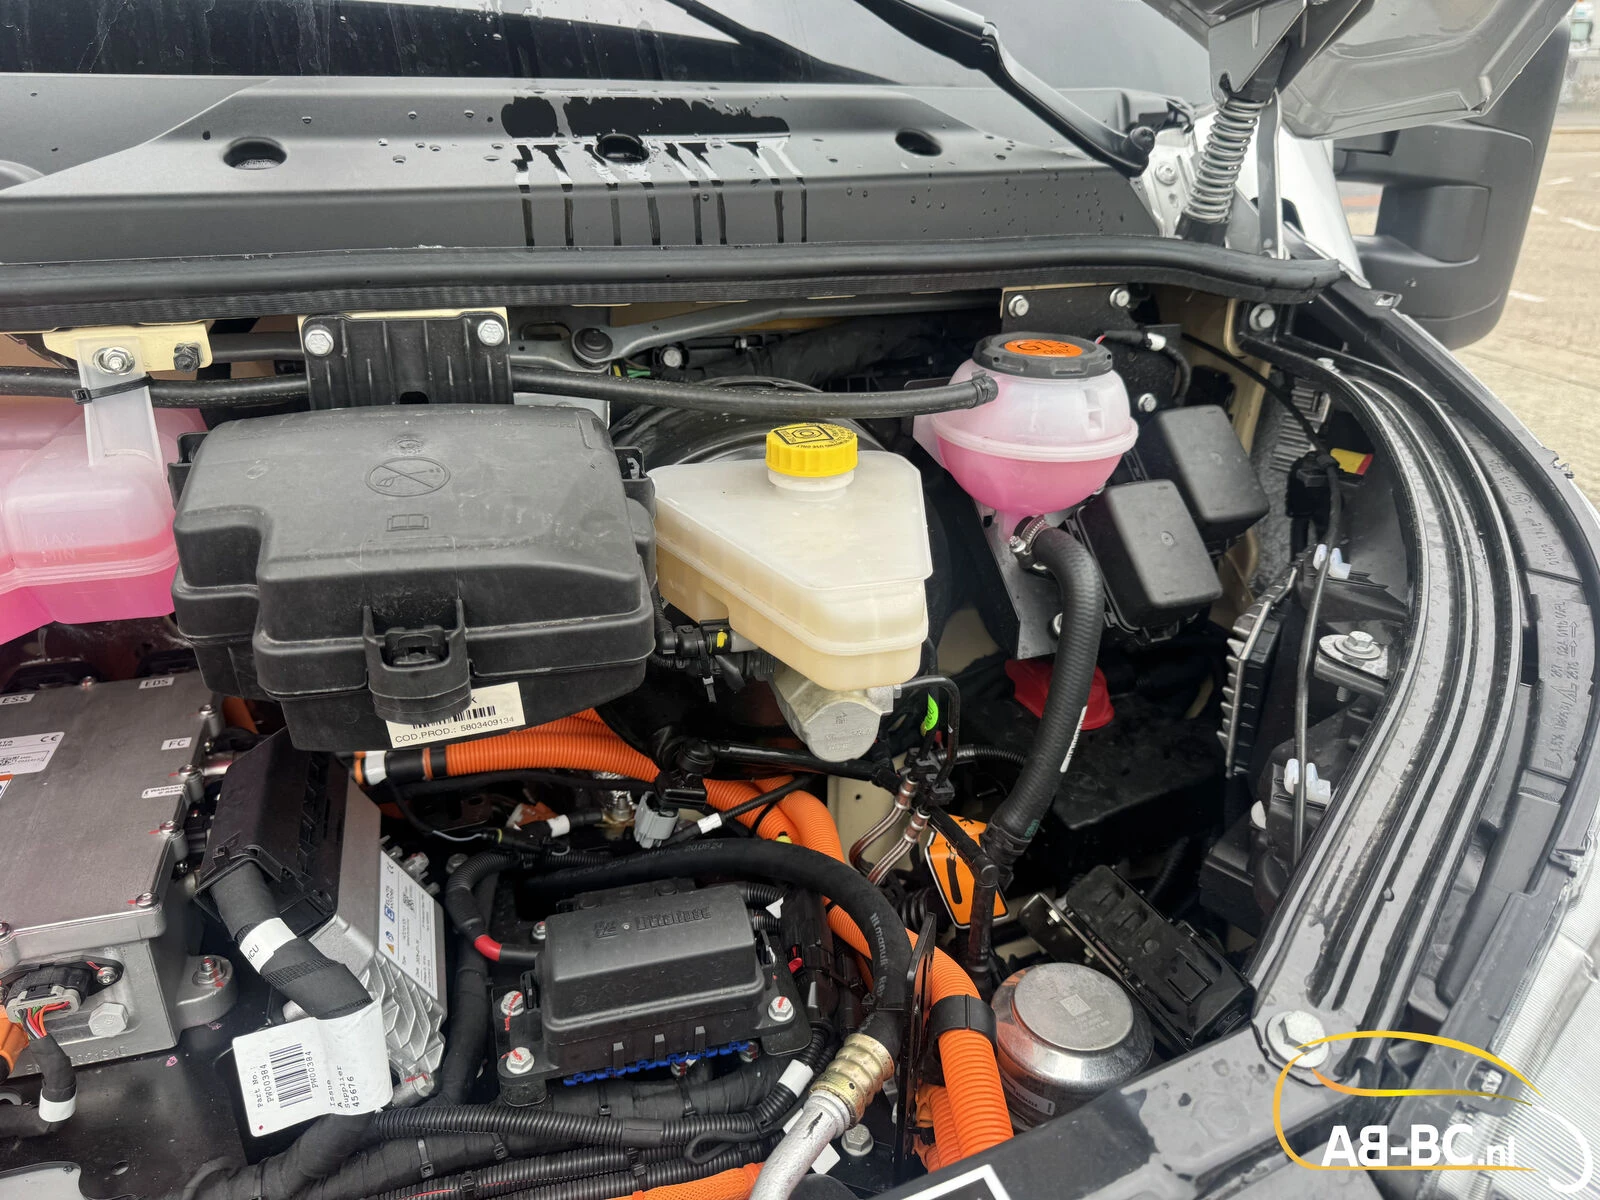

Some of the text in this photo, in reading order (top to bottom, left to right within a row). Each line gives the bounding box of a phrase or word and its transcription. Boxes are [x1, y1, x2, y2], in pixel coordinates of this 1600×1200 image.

[145, 679, 169, 687] EDS
[168, 739, 186, 748] FC
[395, 716, 515, 744] COD.PROD.: 5803409134
[260, 1063, 275, 1104] PW00384
[305, 1050, 319, 1089] PW00384
[254, 1088, 264, 1108] Part
[326, 1079, 336, 1107] Issue
[347, 1076, 360, 1108] 45676
